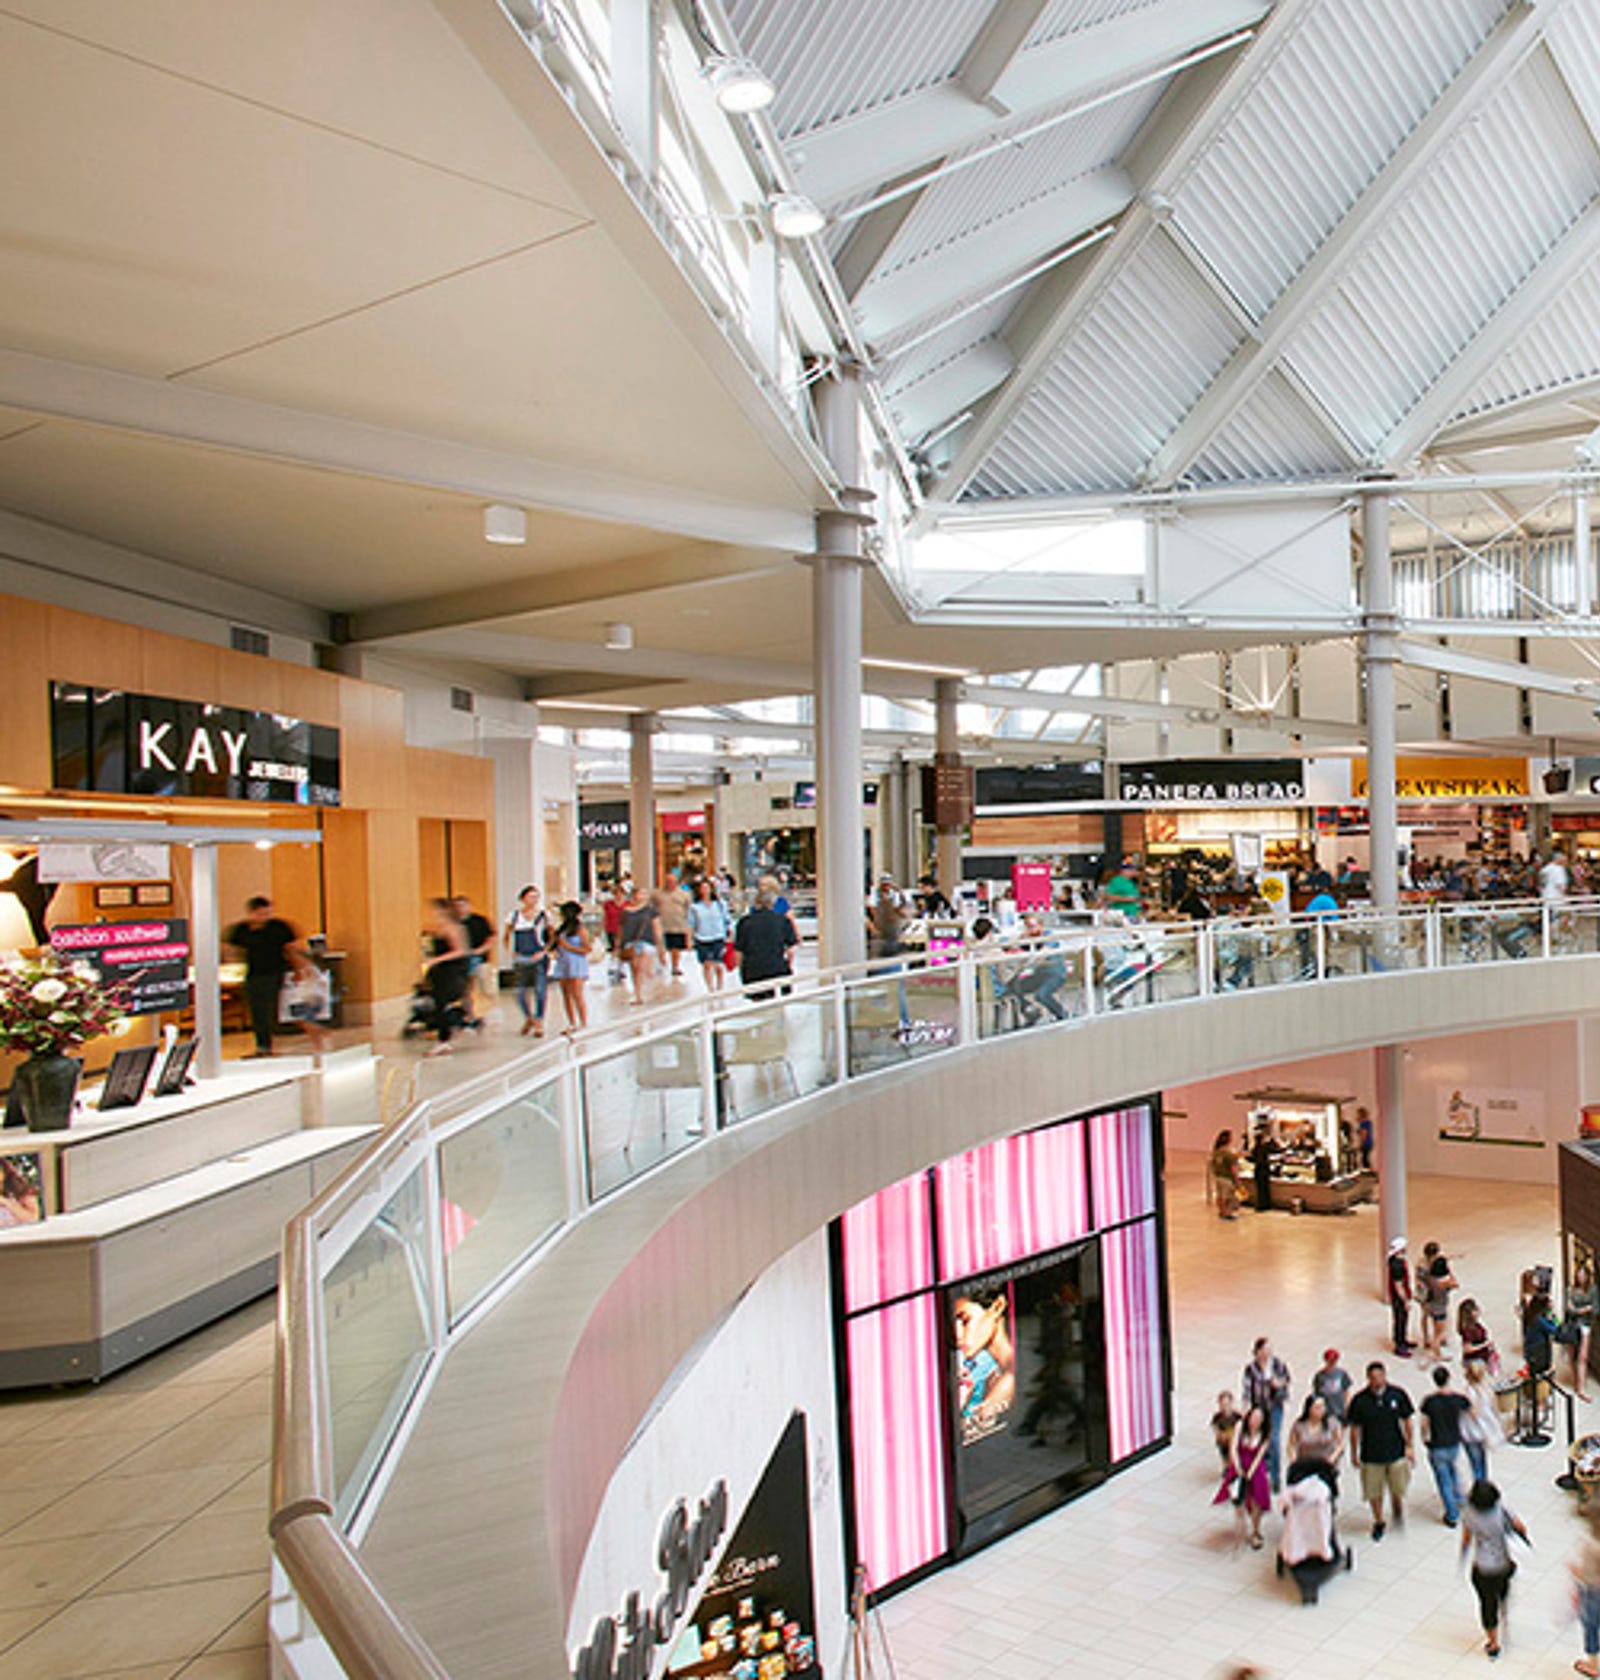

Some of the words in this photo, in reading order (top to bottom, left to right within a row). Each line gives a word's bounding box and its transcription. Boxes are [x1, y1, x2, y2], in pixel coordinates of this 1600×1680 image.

[139, 719, 247, 775] KAY
[1123, 783, 1216, 801] PANERA
[1224, 780, 1303, 799] BREAD
